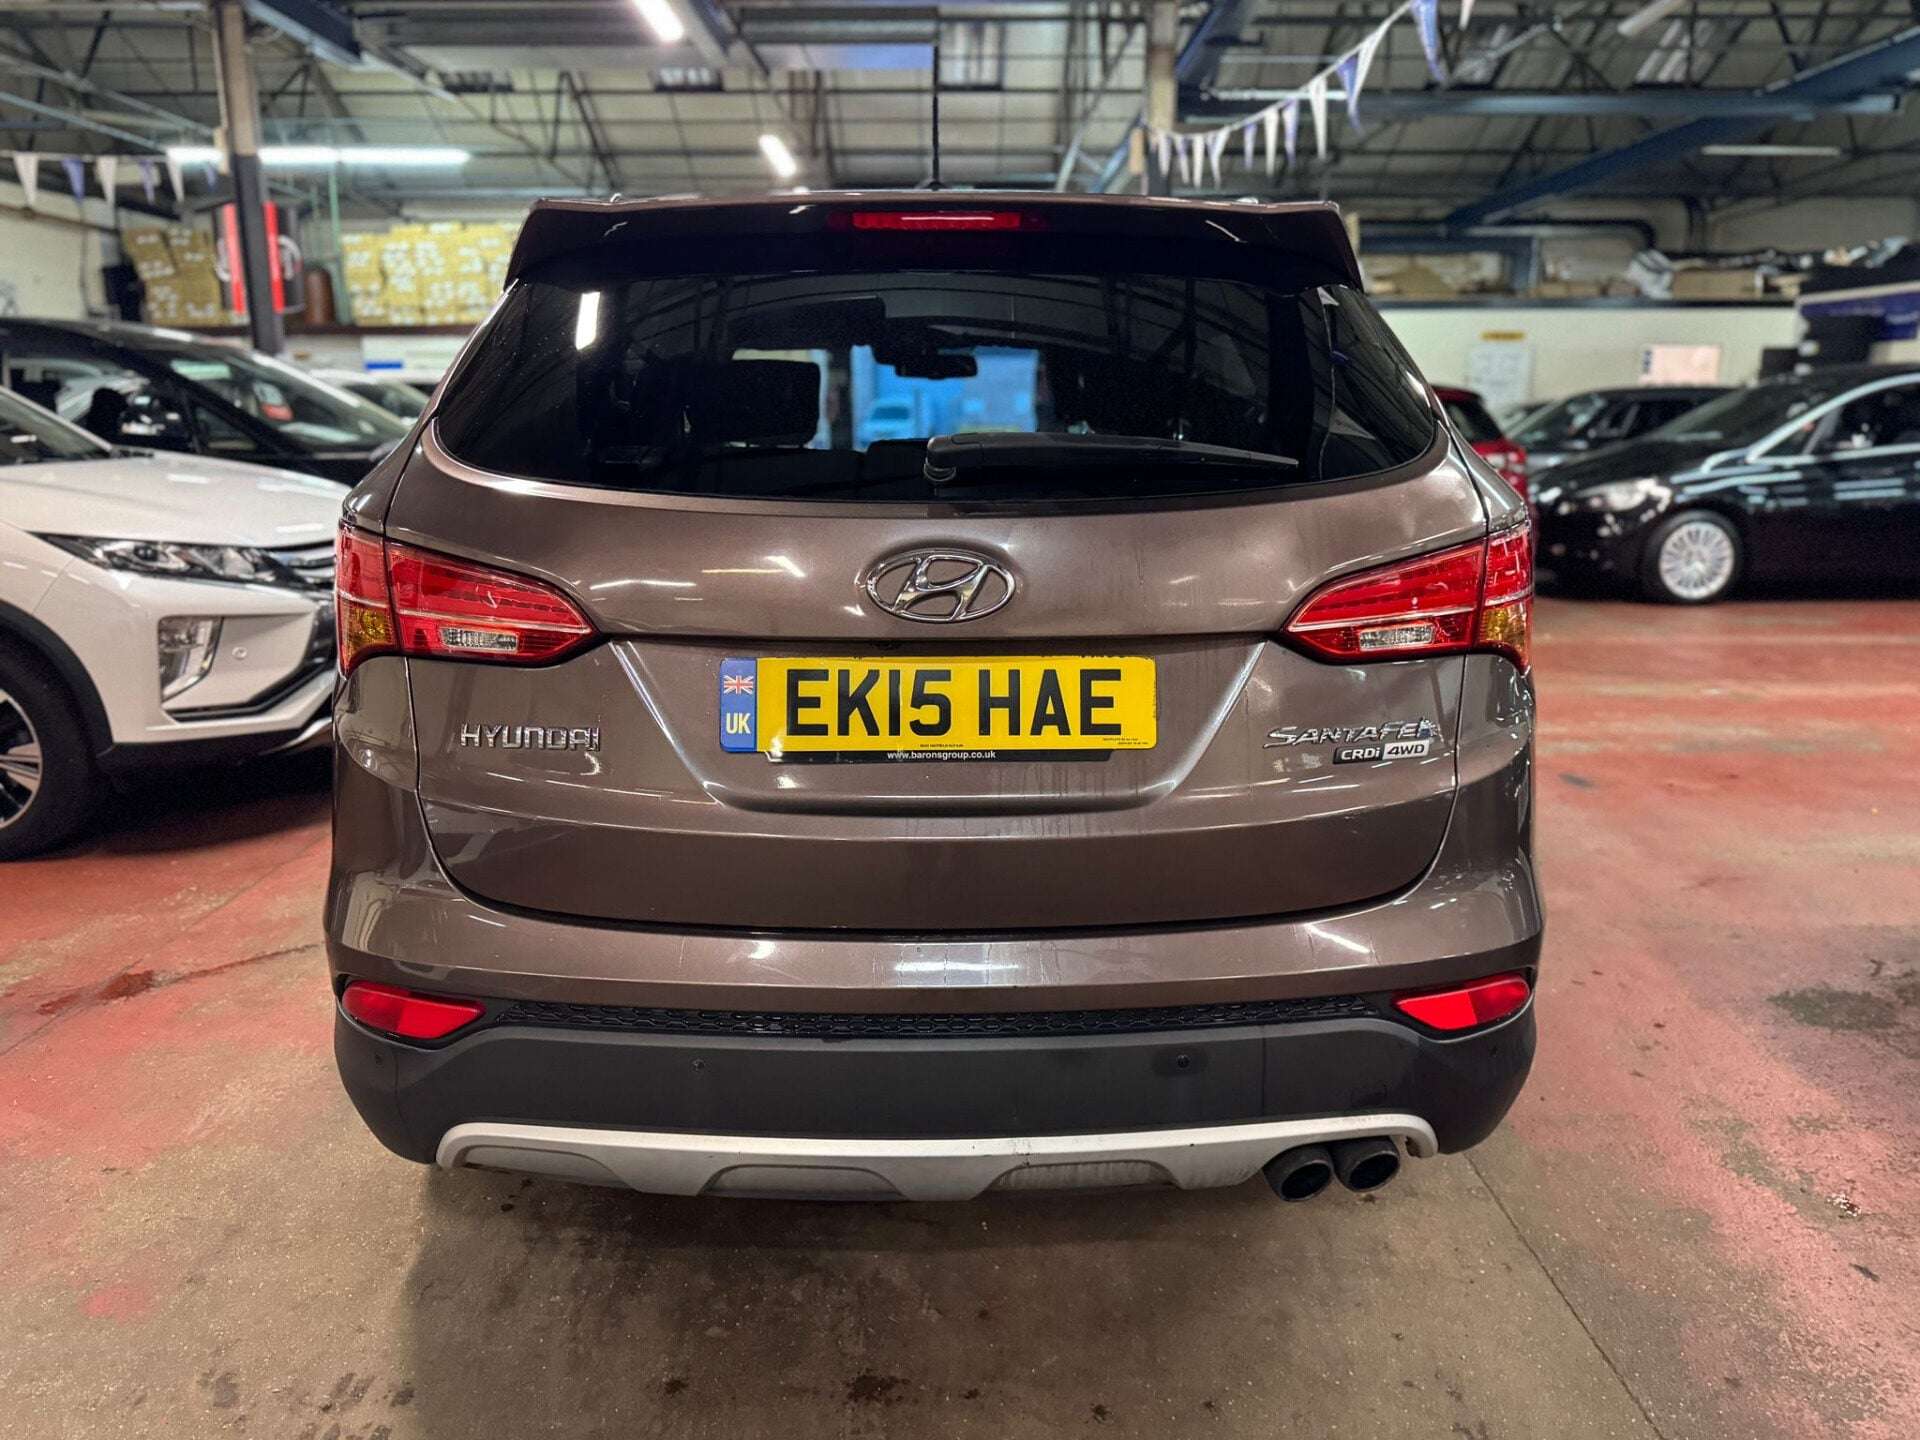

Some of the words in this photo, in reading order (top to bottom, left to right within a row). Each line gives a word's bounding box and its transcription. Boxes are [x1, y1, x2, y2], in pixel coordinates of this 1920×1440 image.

[786, 669, 951, 736] EK15
[978, 669, 1122, 736] HAE
[726, 712, 751, 734] UK
[460, 723, 600, 751] HYUNDAI
[887, 750, 996, 760] www.baronsgroup.co.uk
[1340, 747, 1381, 761] CRDi
[1387, 744, 1425, 757] 4WD
